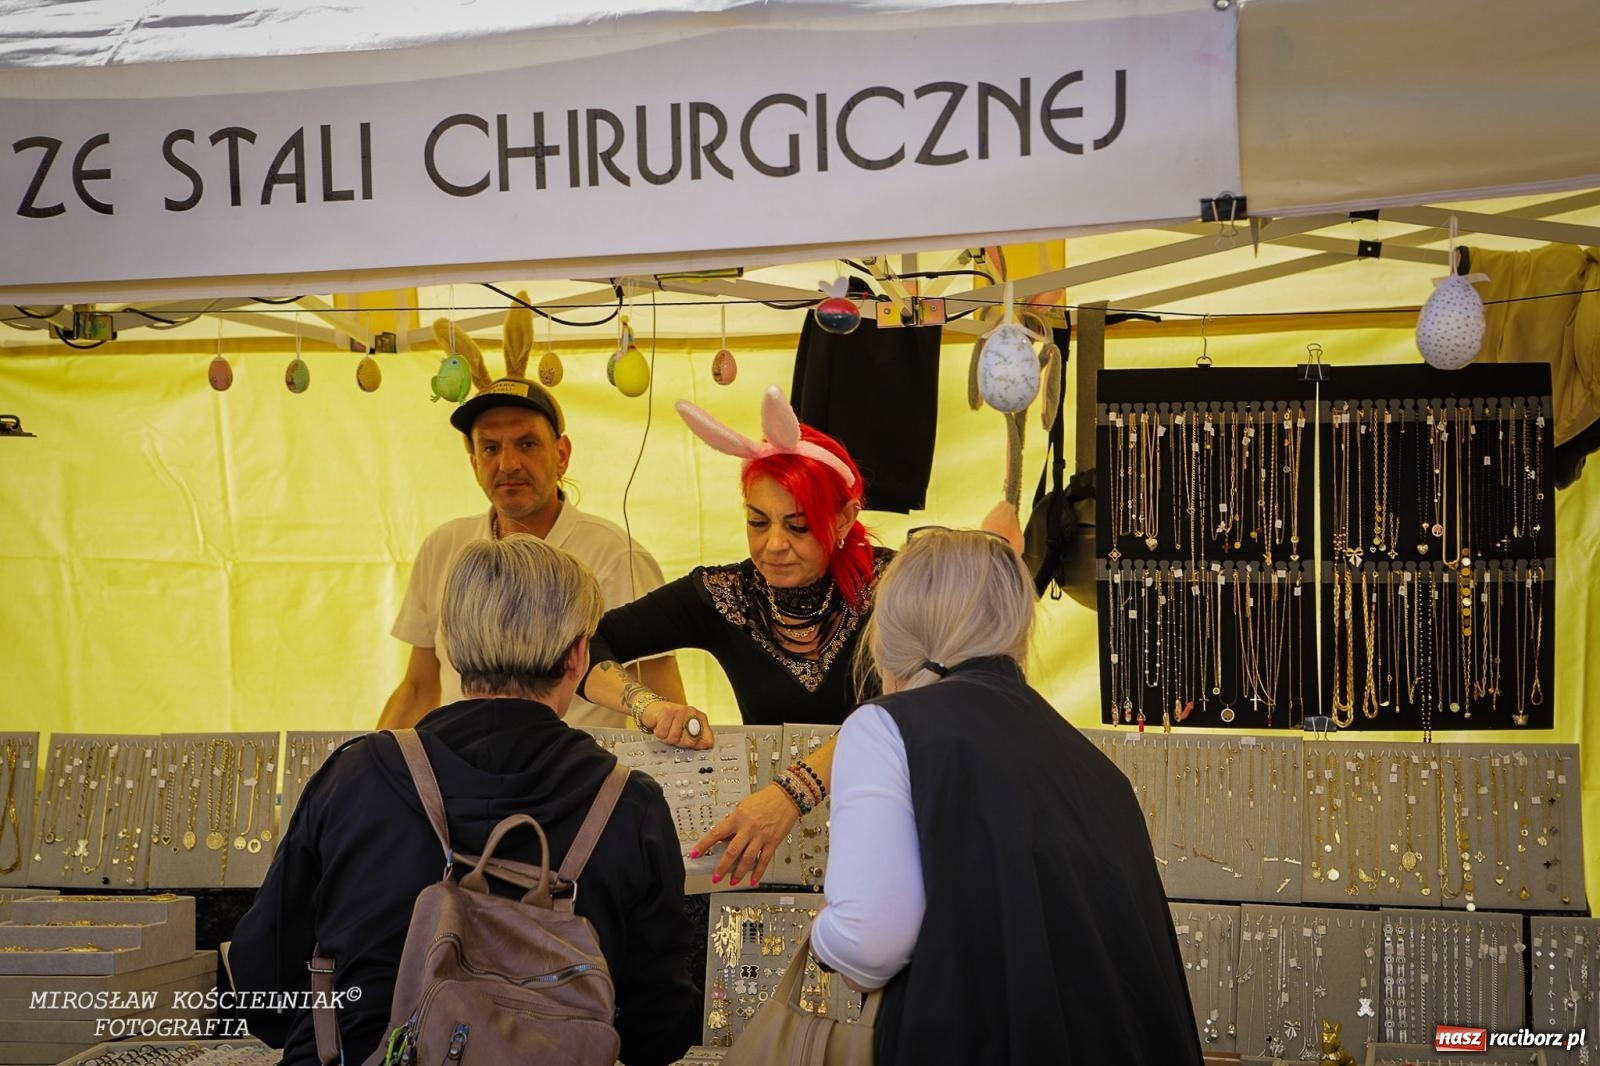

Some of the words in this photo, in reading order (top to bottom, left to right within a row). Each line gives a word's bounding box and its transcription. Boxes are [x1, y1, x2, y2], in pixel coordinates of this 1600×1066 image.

[12, 133, 114, 218] ZE
[163, 122, 373, 212] STALI
[424, 69, 1127, 198] CHIRURGICZNEJ
